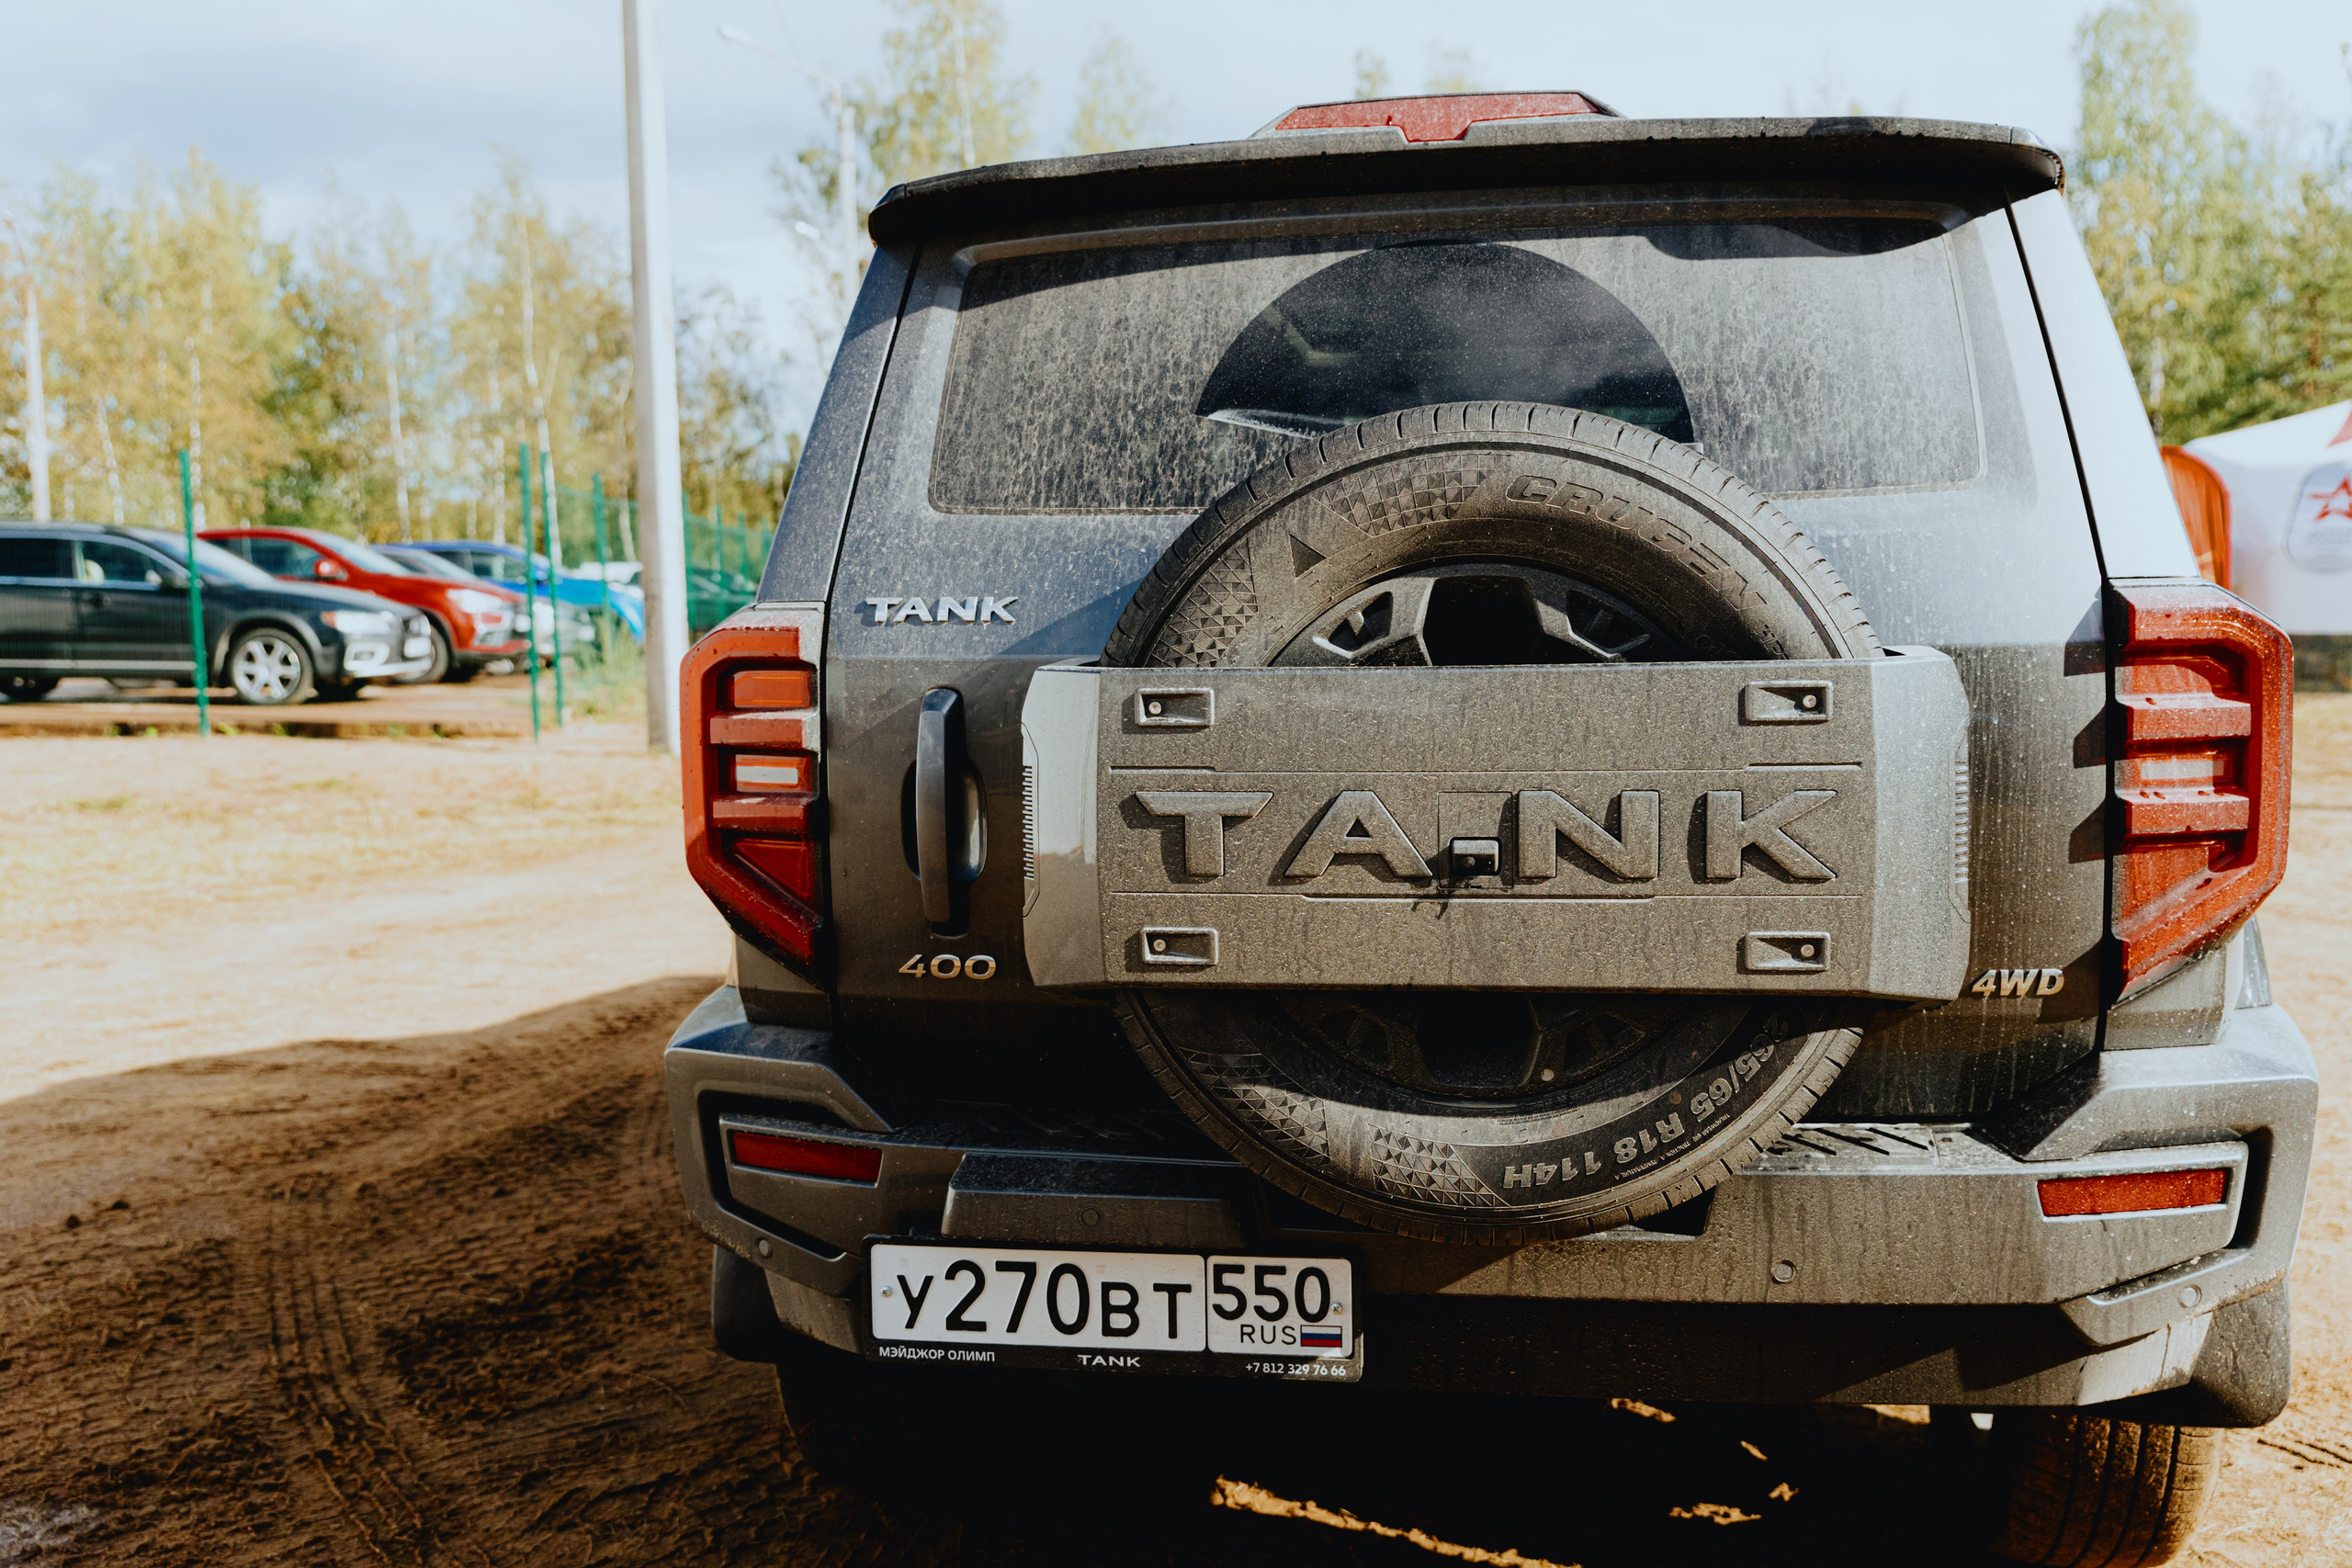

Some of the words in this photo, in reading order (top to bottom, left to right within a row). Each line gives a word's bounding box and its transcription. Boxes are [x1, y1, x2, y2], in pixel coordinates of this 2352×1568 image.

[1505, 474, 1769, 611] CRUGEN
[1752, 624, 1790, 660] HP
[864, 596, 1019, 624] TANK
[1135, 789, 1838, 879] TANK
[899, 953, 997, 980] 400
[1971, 968, 2065, 997] 4WD
[1690, 1011, 1789, 1122] 265/65
[1613, 1111, 1685, 1164] R18
[1503, 1151, 1601, 1190] 114H
[1212, 1264, 1331, 1324] 550
[1240, 1324, 1297, 1346] RUS
[878, 1345, 945, 1360] МЭЙДЖОР
[947, 1348, 995, 1362] ОЛИМП
[1077, 1354, 1141, 1368] TANK
[1246, 1362, 1260, 1372] +7
[1262, 1363, 1284, 1374] 812
[1287, 1363, 1310, 1375] 329
[1313, 1364, 1328, 1376] 76
[1330, 1365, 1347, 1377] 66
